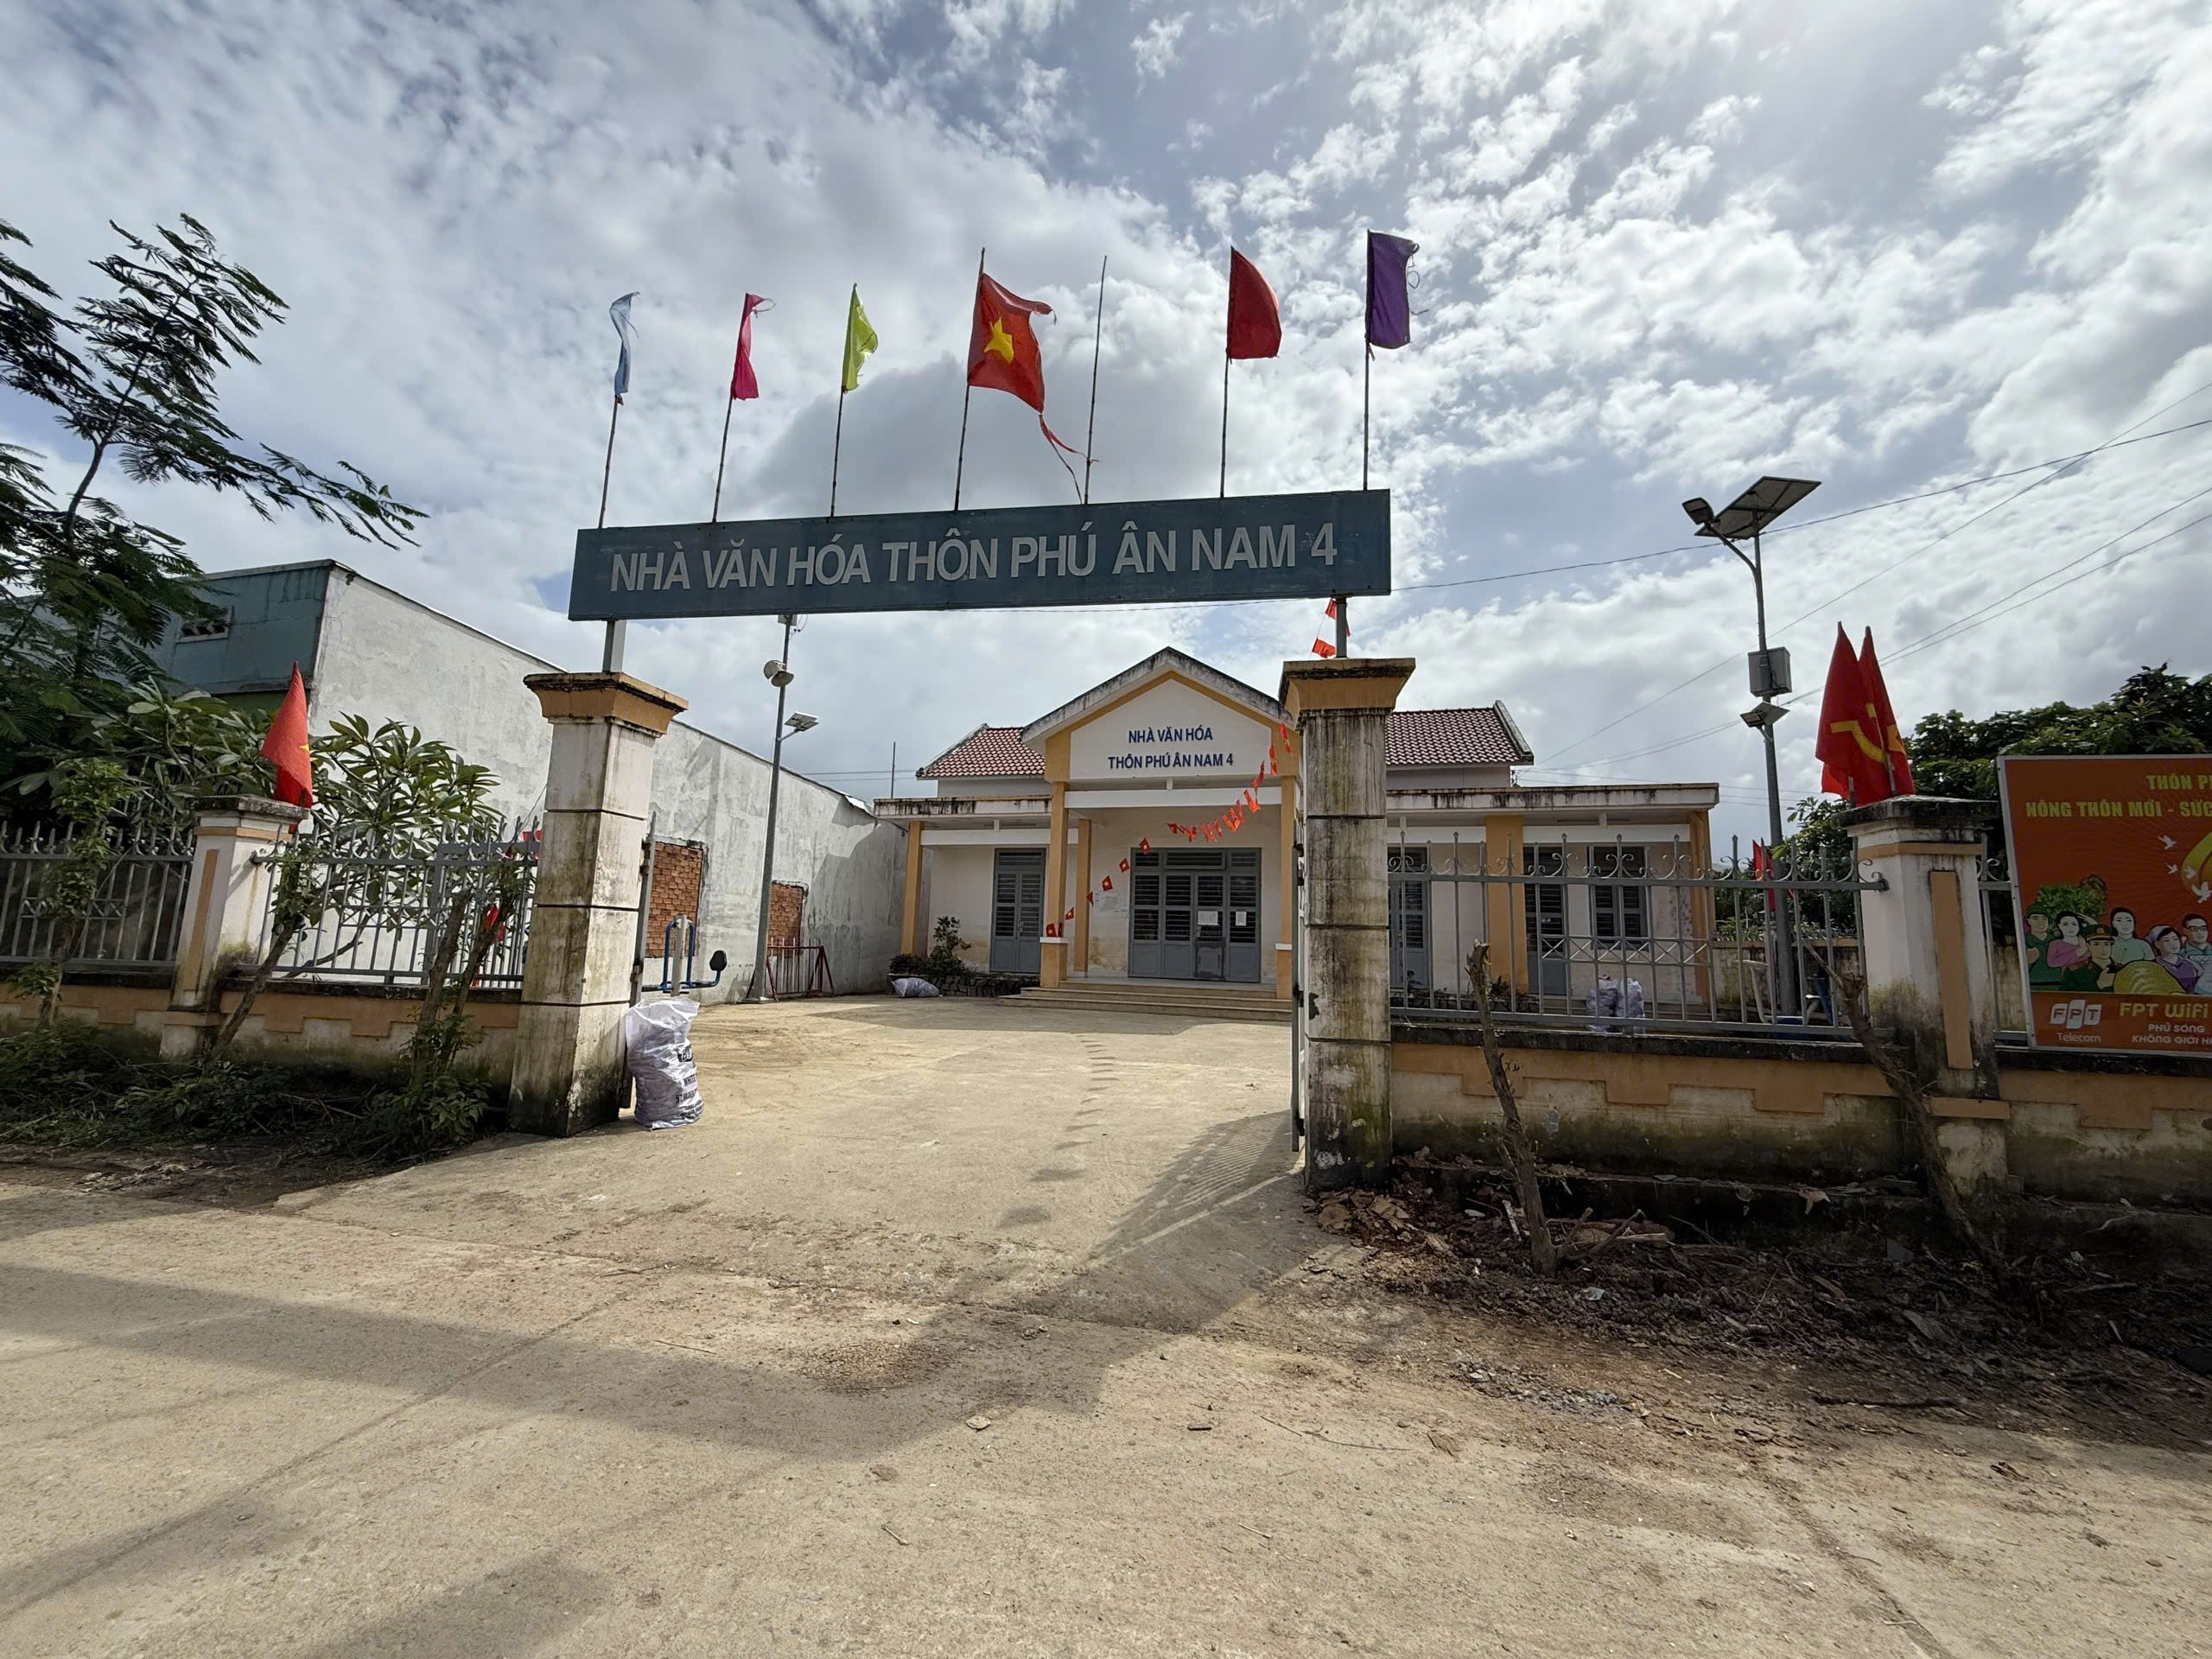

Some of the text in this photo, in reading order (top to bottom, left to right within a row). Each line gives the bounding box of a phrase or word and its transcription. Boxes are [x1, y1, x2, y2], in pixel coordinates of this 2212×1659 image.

[610, 520, 1338, 591] NHÀ VĂN HÓA THÔN PHÚ ÂN NAM 4
[1128, 724, 1213, 743] NHÀ VĂN HÓA
[1108, 752, 1234, 769] THÔN PHÚ ÂN NAM 4
[2145, 772, 2192, 790] THÔN
[2025, 799, 2073, 817] NÔNG
[2077, 798, 2123, 817] THÔN
[2127, 798, 2163, 817] MỚI
[2119, 1001, 2158, 1017] FPT
[2056, 1032, 2101, 1044] Telecom
[2132, 1034, 2171, 1044] KHÔNG
